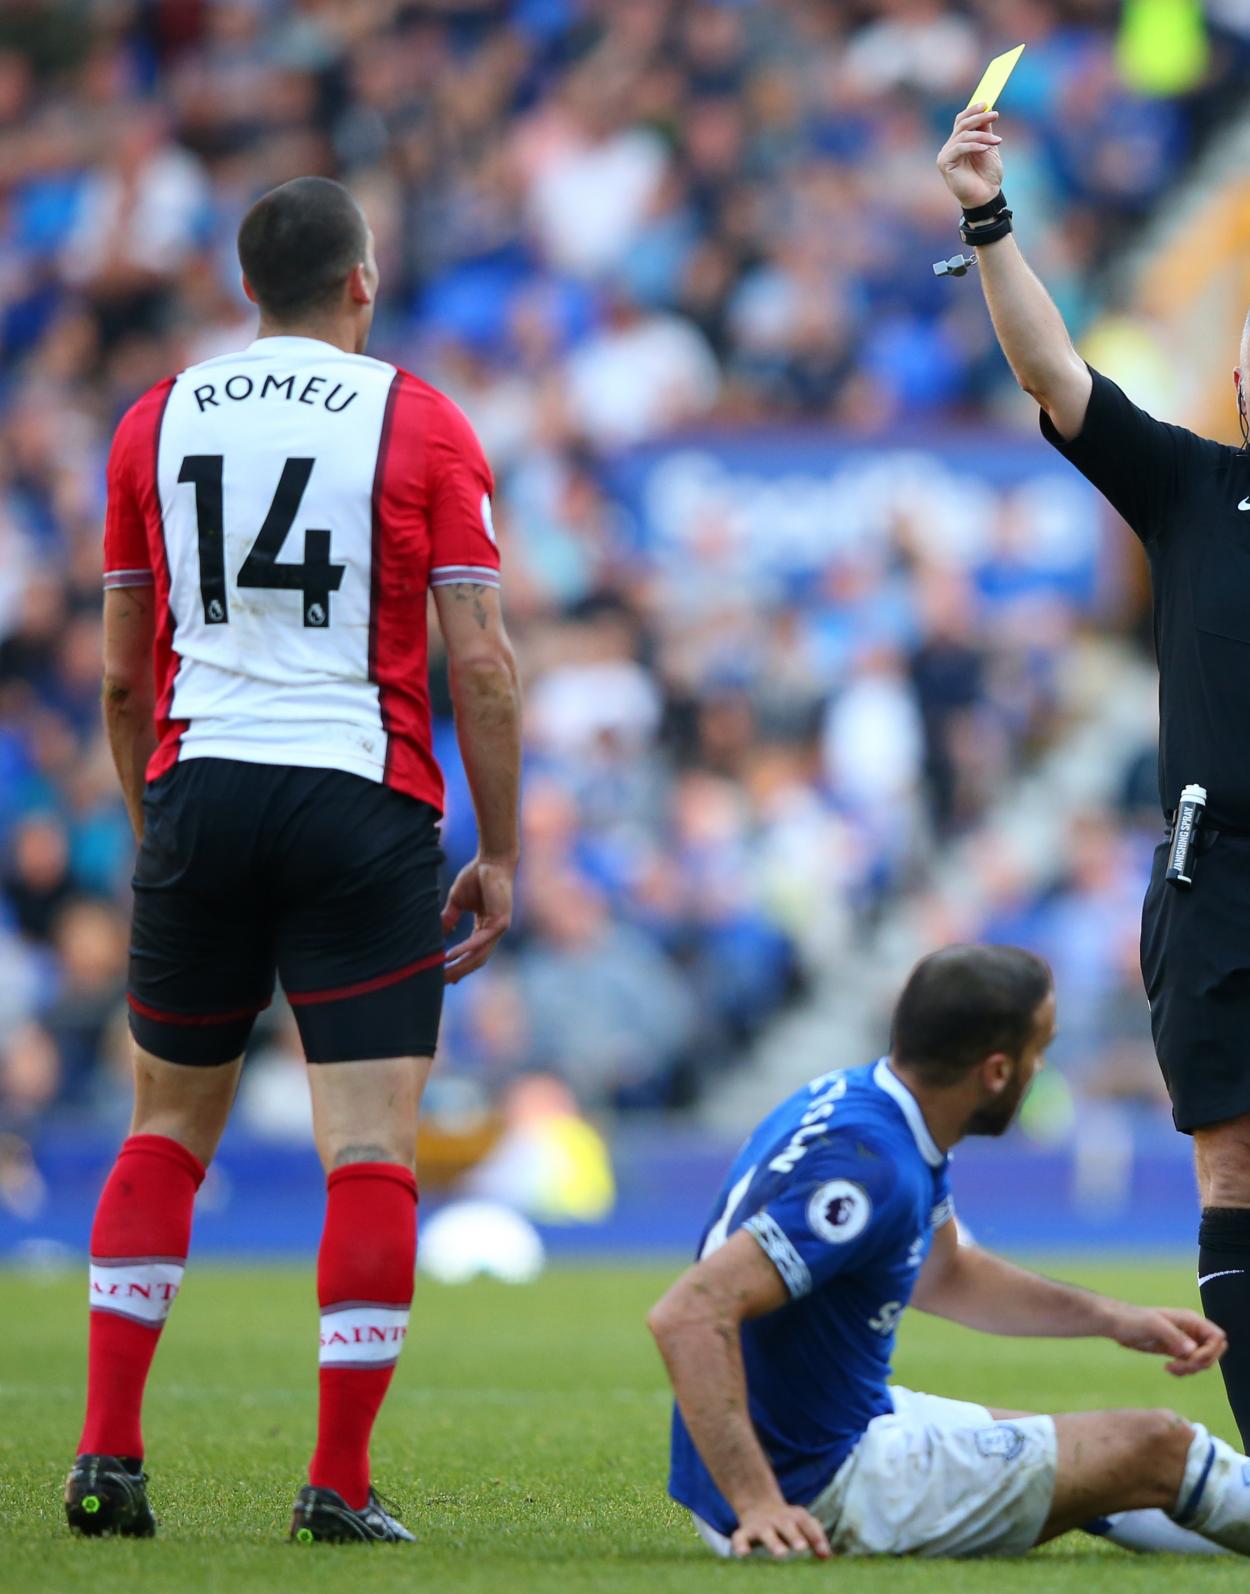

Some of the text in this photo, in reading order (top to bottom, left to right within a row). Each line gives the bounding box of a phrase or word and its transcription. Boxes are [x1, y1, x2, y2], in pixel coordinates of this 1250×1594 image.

[193, 374, 360, 413] ROMEU
[177, 454, 347, 627] 14
[1181, 806, 1194, 832] SPRAY
